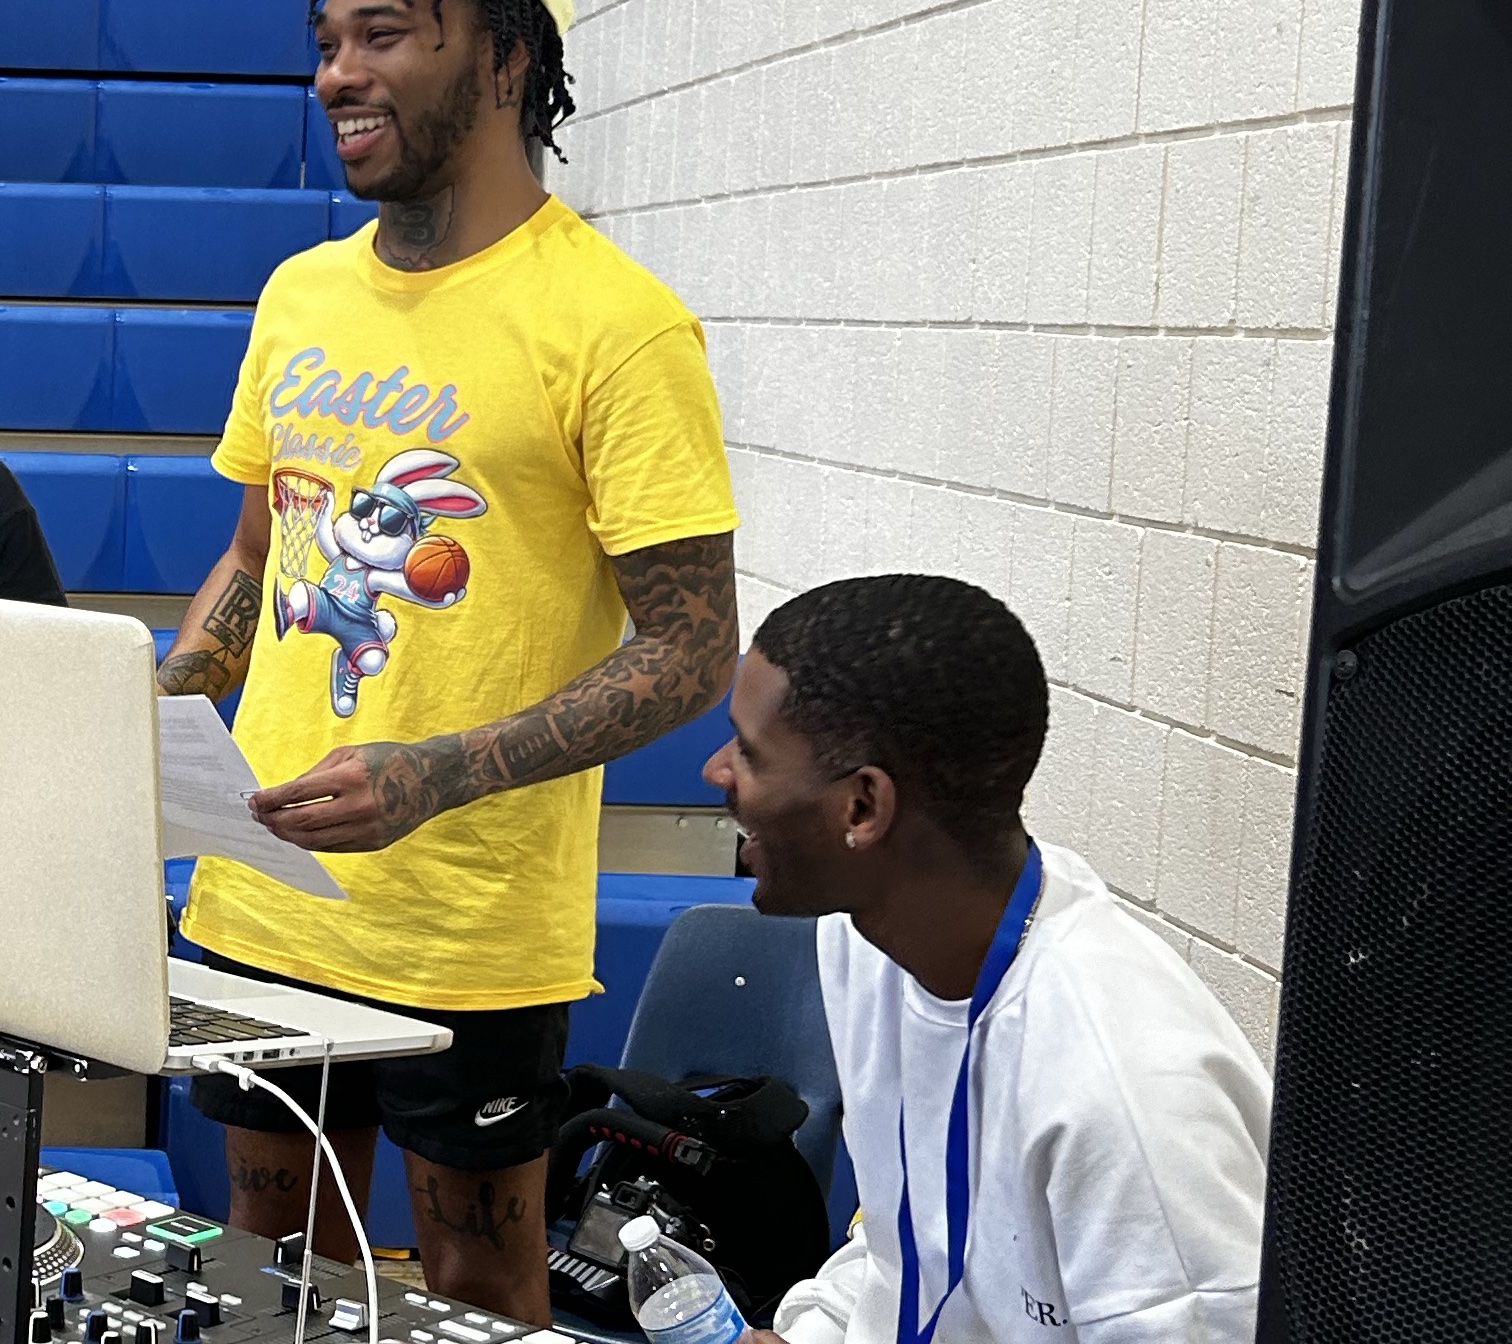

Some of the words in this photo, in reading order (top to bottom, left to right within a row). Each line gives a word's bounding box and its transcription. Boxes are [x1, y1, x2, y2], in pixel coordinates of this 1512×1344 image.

[269, 346, 471, 444] Easter
[272, 423, 364, 472] Classic
[332, 574, 361, 605] 24
[481, 1096, 519, 1115] NIKE
